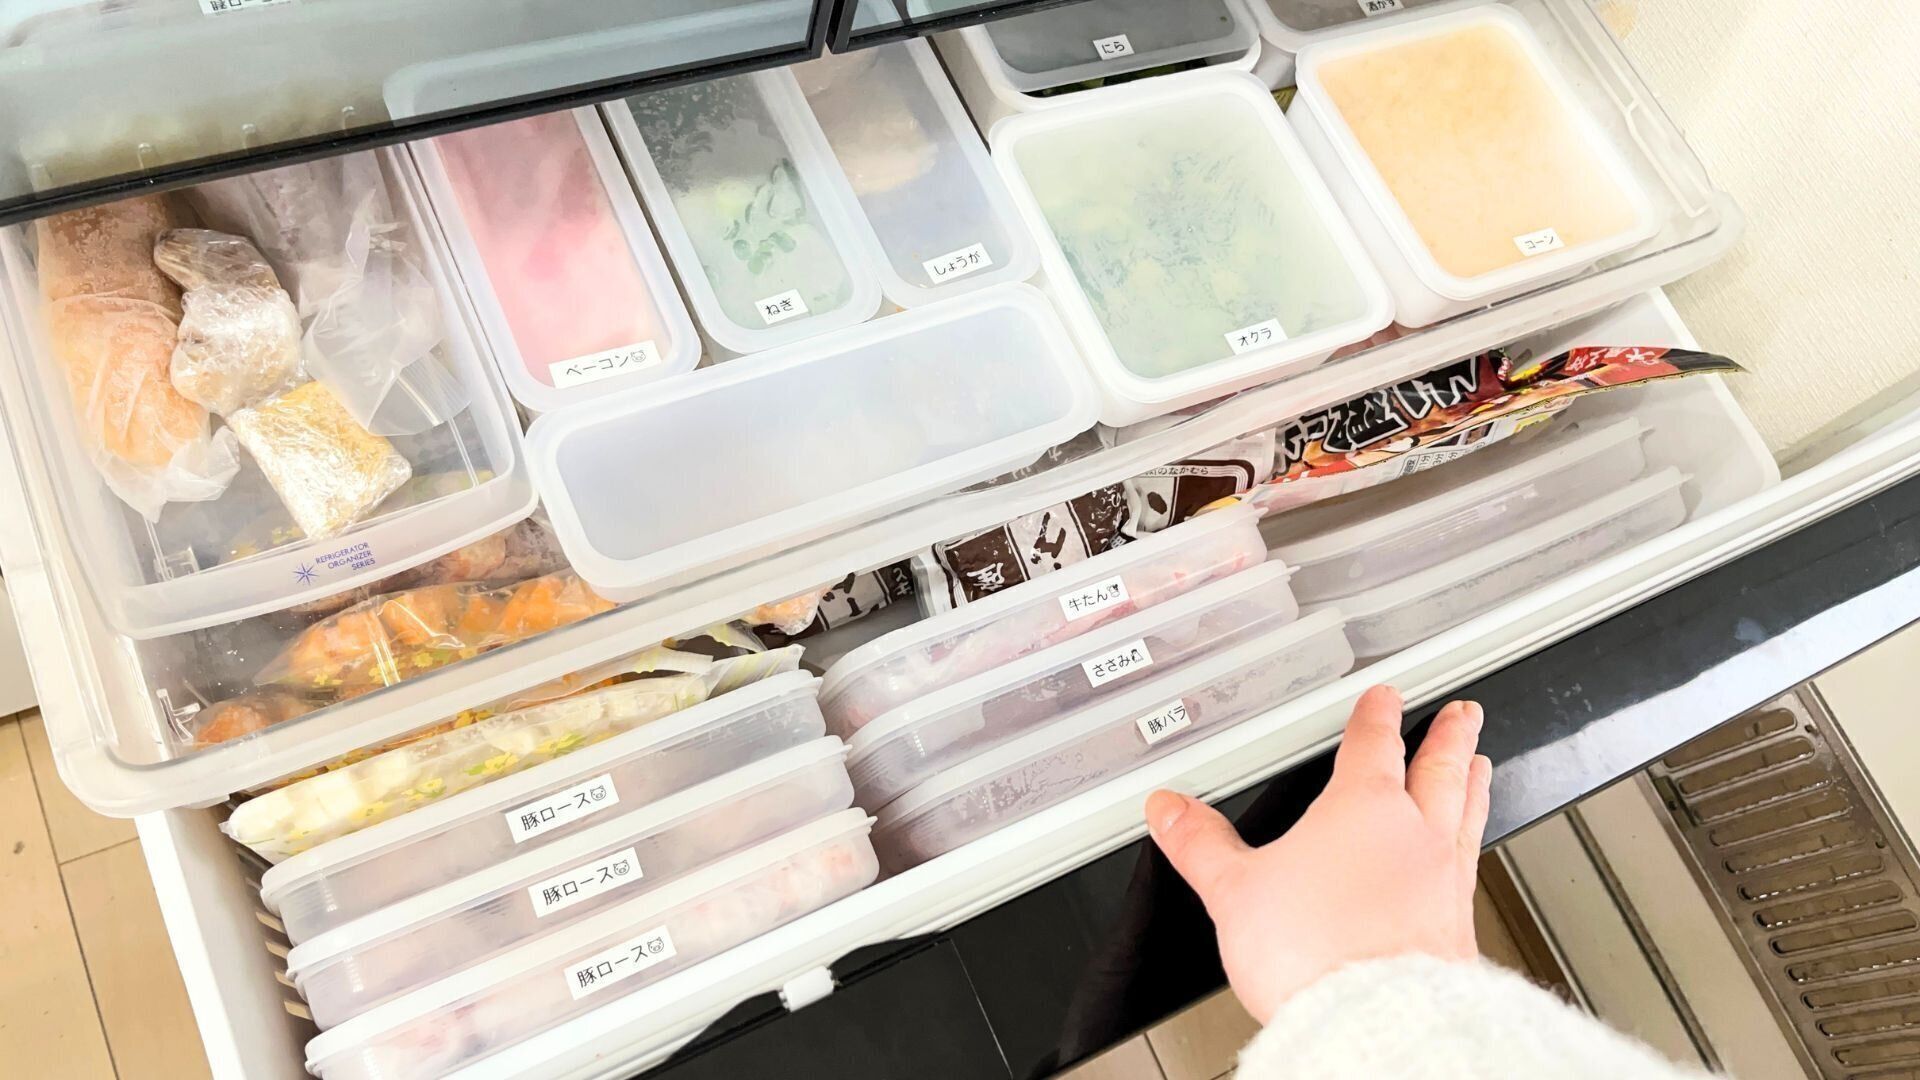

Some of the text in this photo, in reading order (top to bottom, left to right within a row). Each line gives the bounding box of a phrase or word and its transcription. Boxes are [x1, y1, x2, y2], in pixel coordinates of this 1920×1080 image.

[1101, 41, 1125, 54] にら
[1524, 235, 1554, 249] コーン
[933, 250, 981, 276] しょうが
[765, 298, 794, 317] ねぎ
[1237, 327, 1272, 347] オクラ
[566, 355, 629, 375] ベーコン
[315, 542, 370, 565] REFRIGERATOR
[327, 550, 373, 570] ORGANIZER
[351, 557, 376, 571] SERIES
[1068, 588, 1109, 612] 牛たん
[1092, 654, 1131, 678] ささみ
[1147, 705, 1186, 735] 豚バラ
[520, 792, 592, 832] 豚ロース
[542, 866, 614, 907] 豚ロース
[576, 944, 649, 989] 豚ロース
